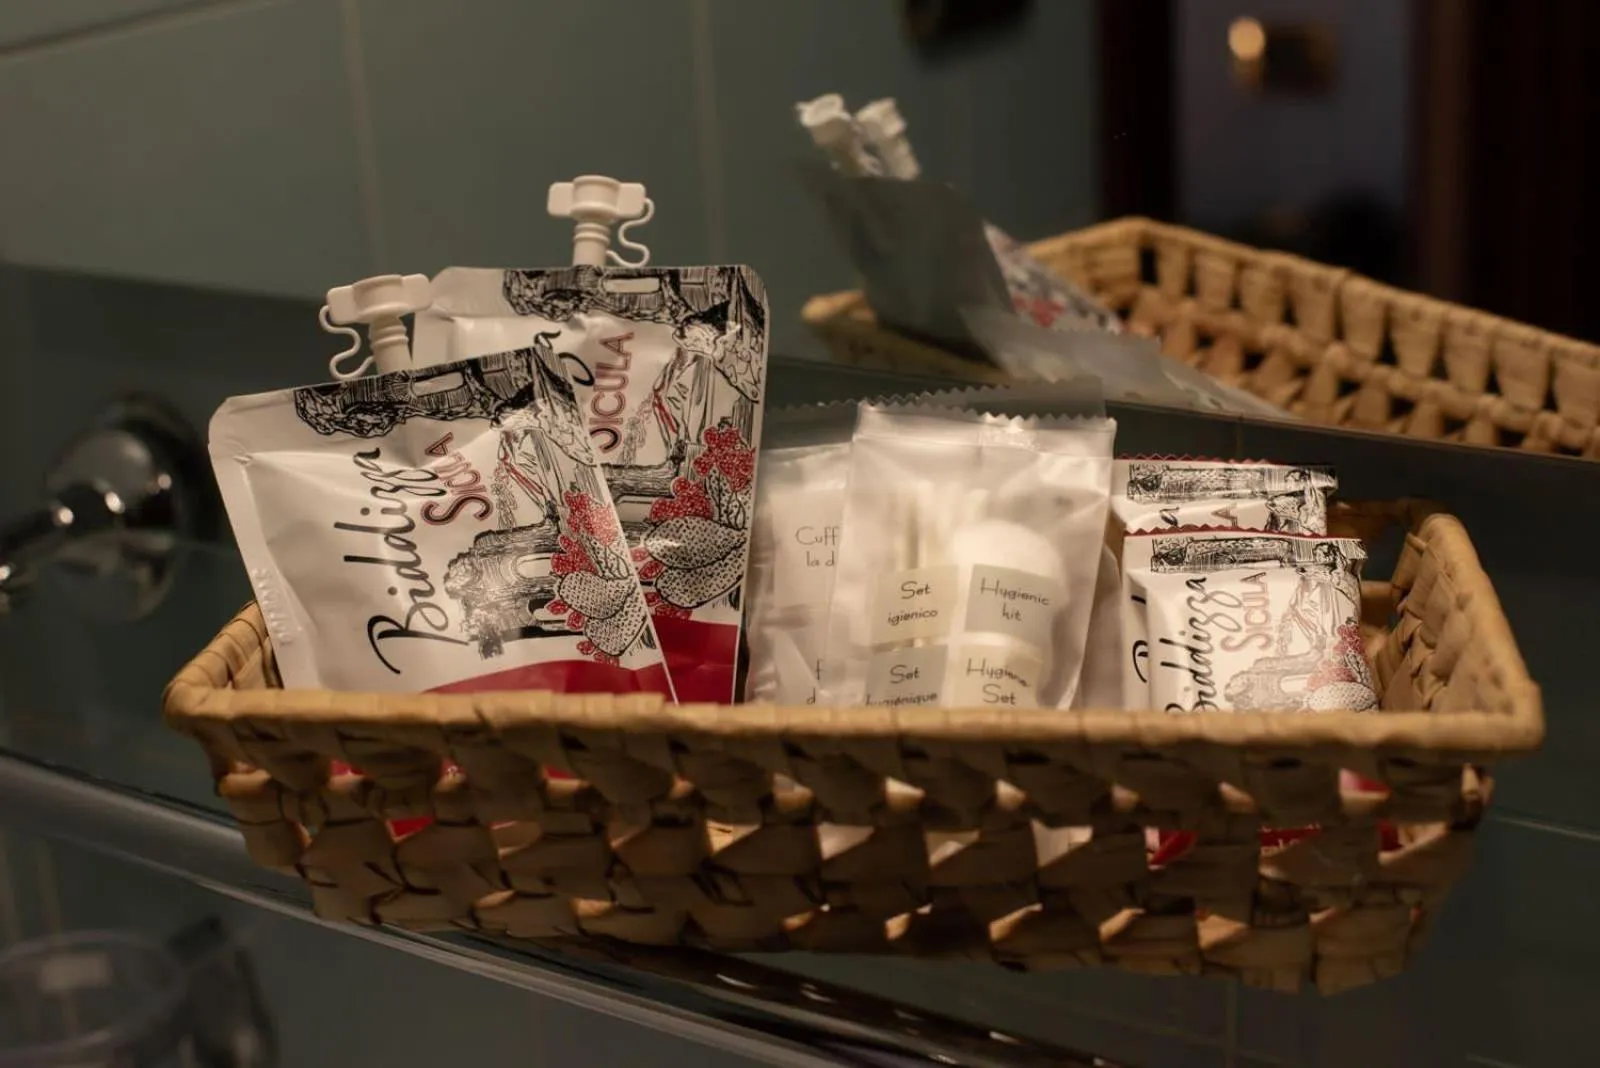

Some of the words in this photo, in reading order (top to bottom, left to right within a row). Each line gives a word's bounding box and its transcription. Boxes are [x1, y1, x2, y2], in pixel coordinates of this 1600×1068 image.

[334, 447, 470, 674] Biddizza
[900, 580, 931, 600] Set
[980, 577, 1050, 606] Hygienic
[888, 608, 939, 626] igienico
[1002, 603, 1023, 622] kit
[1220, 571, 1274, 652] SICULA
[1159, 577, 1243, 712] iddizza
[889, 664, 920, 684] Set
[982, 683, 1017, 705] Set
